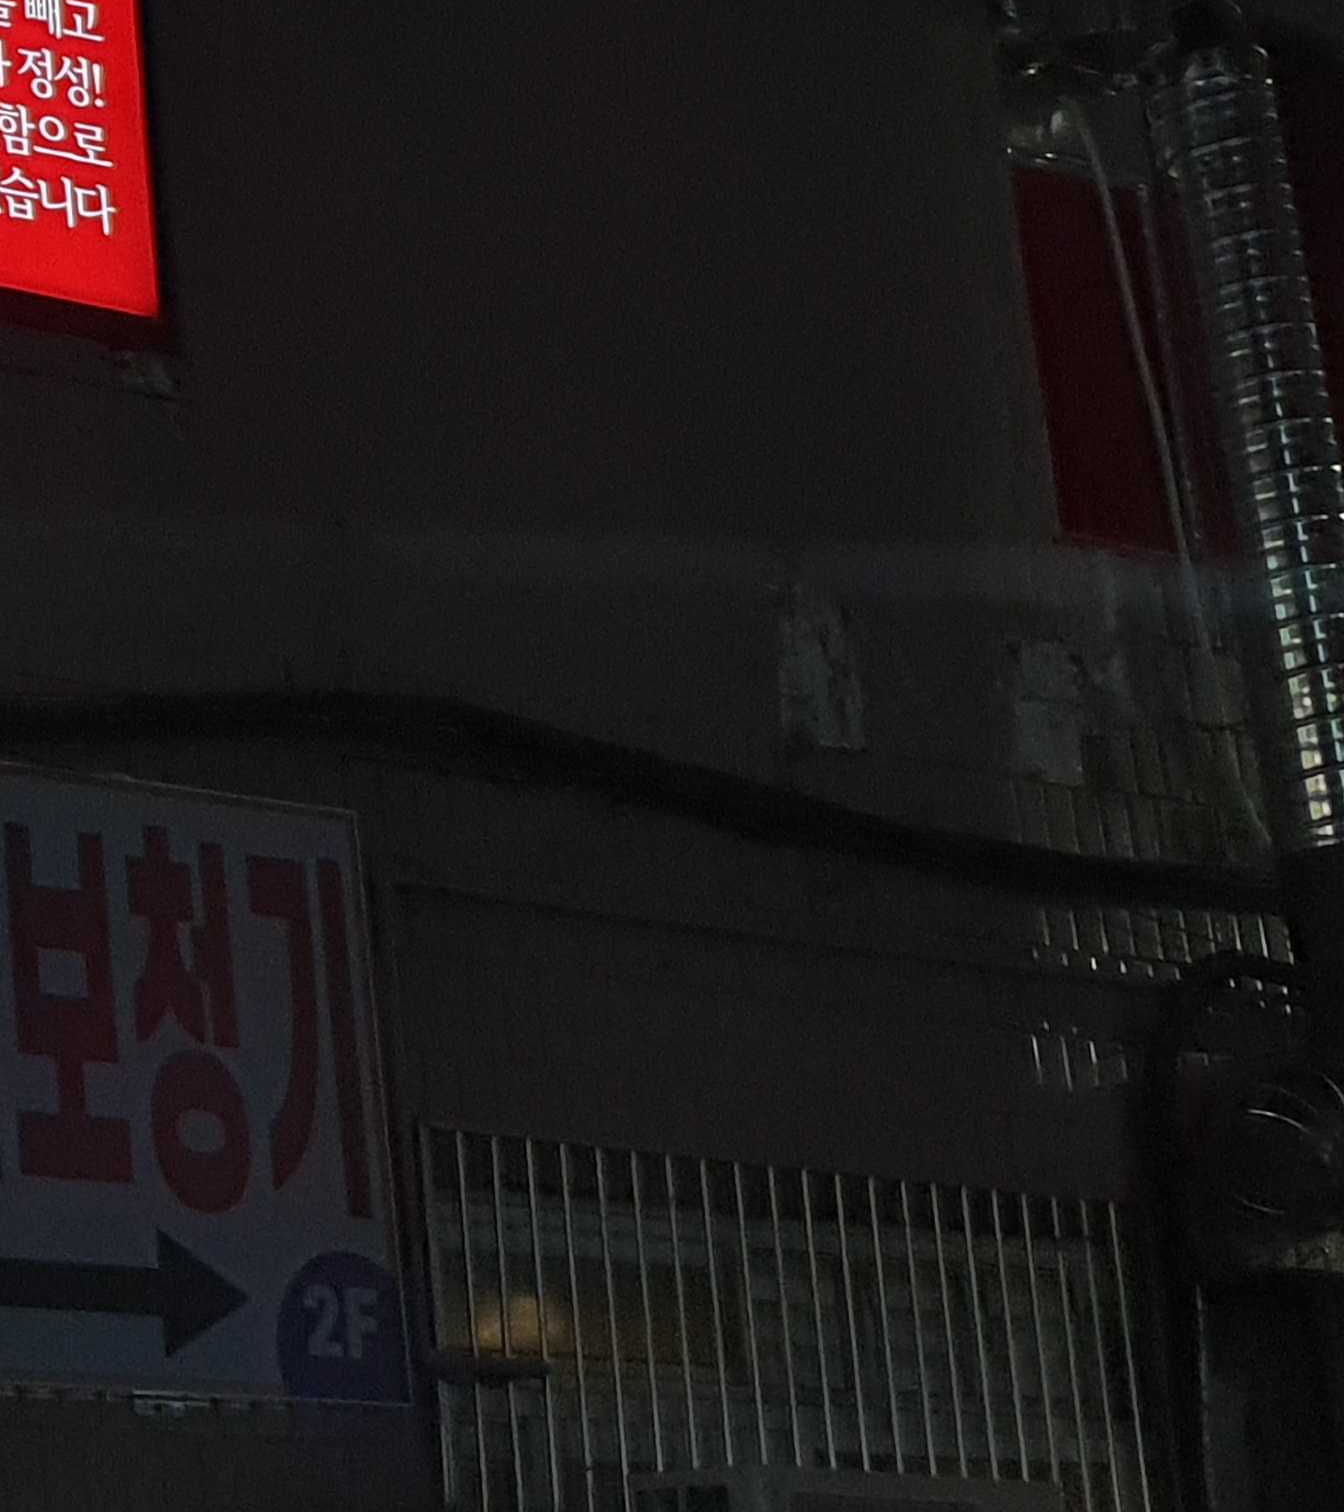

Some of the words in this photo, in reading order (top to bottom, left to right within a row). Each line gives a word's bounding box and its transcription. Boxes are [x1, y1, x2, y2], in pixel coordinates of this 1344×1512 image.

[17, 48, 104, 108] 정성!
[3, 822, 373, 1219] 보청기
[305, 1284, 381, 1360] 2F
